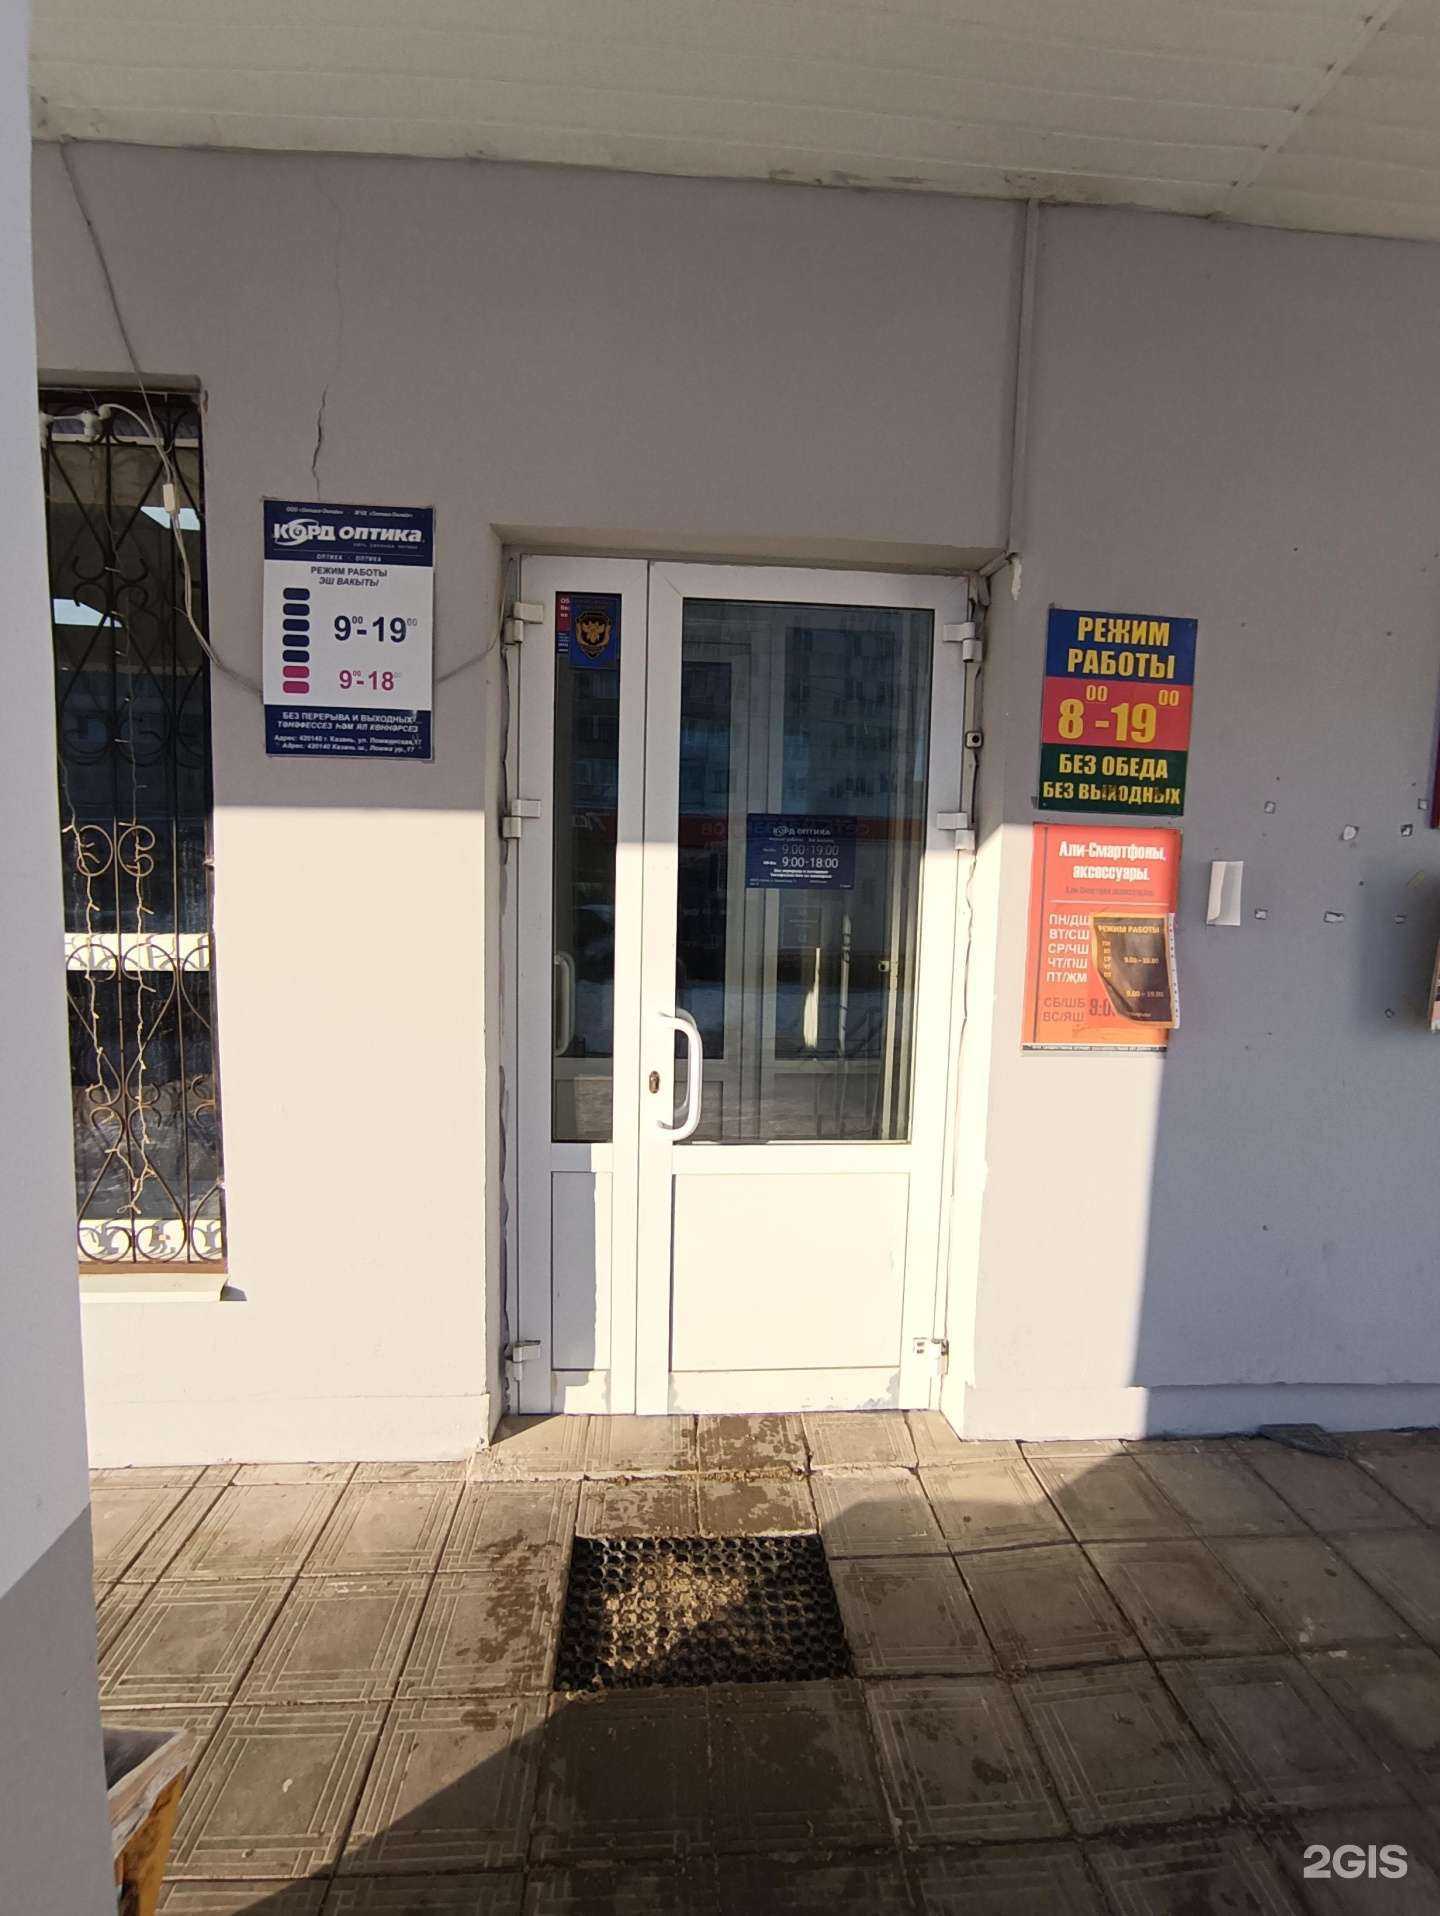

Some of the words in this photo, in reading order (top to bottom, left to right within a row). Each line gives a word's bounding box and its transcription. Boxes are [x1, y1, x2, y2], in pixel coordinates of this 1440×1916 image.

[273, 520, 336, 545] КОРД
[310, 566, 346, 577] РЕЖИМ
[347, 567, 388, 578] РАБОТЫ
[318, 577, 334, 586] ЭШ
[336, 578, 380, 587] ВАКЫТЫ
[1077, 616, 1171, 647] РЕЖИМ
[1067, 648, 1176, 679] РАБОТЫ
[282, 711, 300, 720] БЕЗ
[301, 712, 350, 722] ПЕРЕРЫВА
[351, 714, 359, 722] И
[1059, 753, 1096, 775] БЕЗ
[1102, 755, 1168, 781] ОБЕДА
[1043, 781, 1074, 799] БЕЗ
[1048, 929, 1090, 940] ВТ/СШ
[1047, 943, 1089, 955] СР/ЧШ
[1043, 997, 1086, 1009] СБ/ШБ
[1042, 1011, 1085, 1023] ВС/ЯШ
